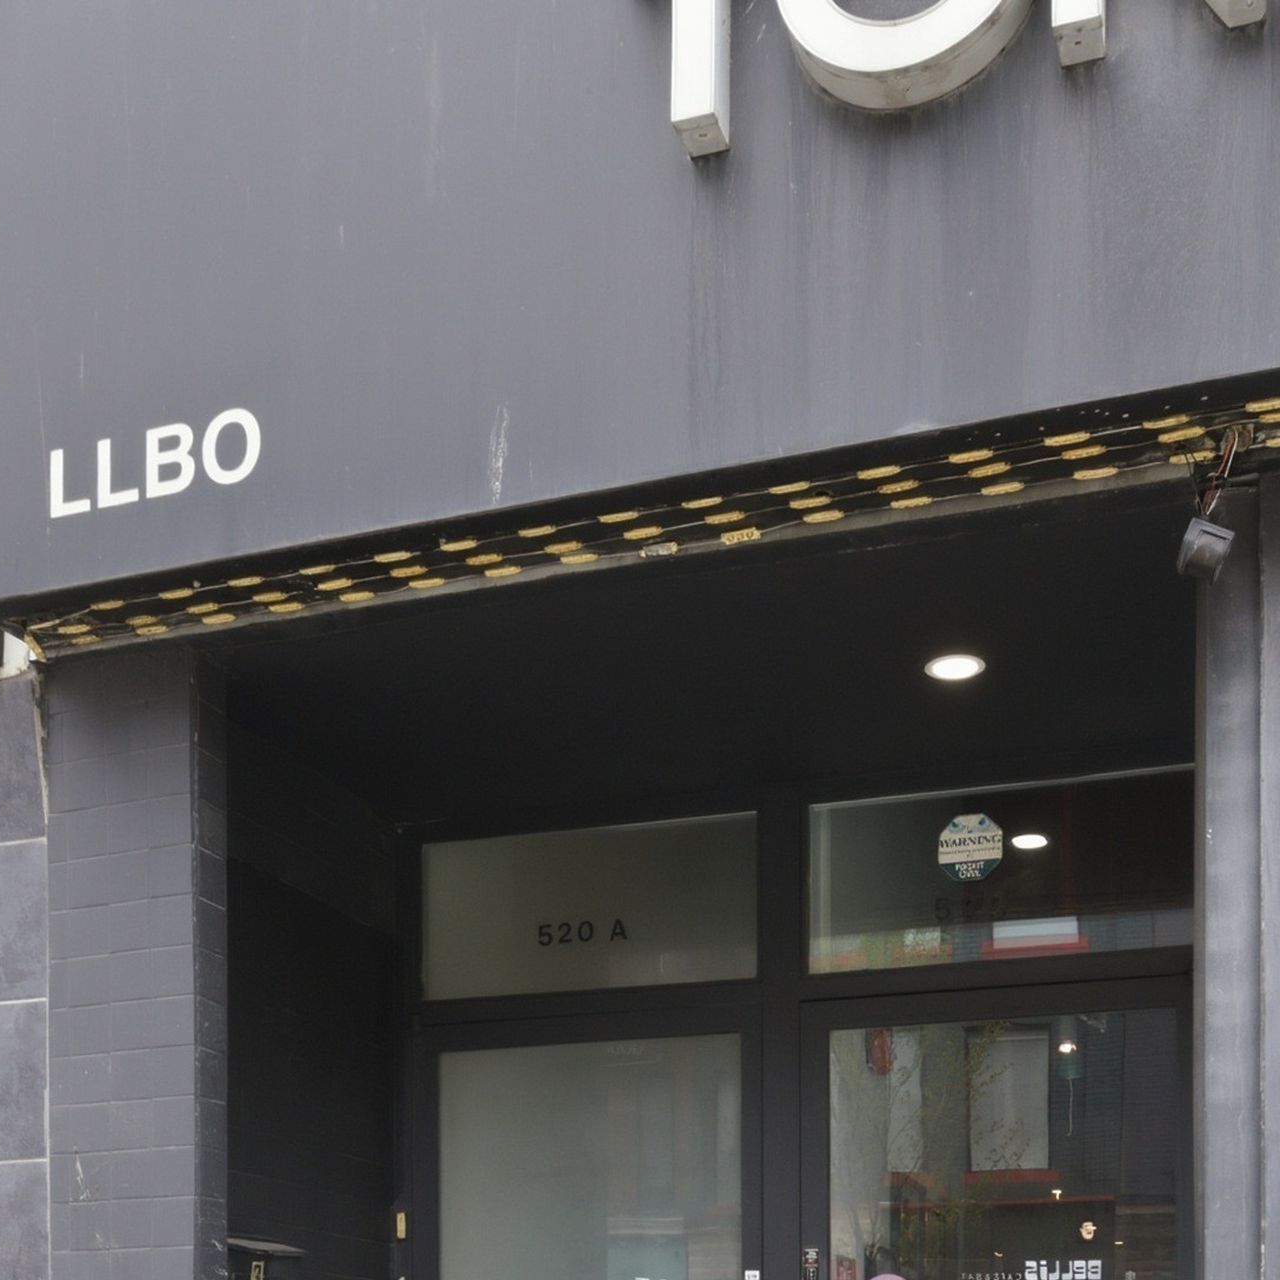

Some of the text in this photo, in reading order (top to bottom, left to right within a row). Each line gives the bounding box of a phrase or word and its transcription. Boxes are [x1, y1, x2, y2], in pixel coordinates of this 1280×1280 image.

[48, 408, 262, 519] LLBO
[537, 917, 629, 946] 520 A
